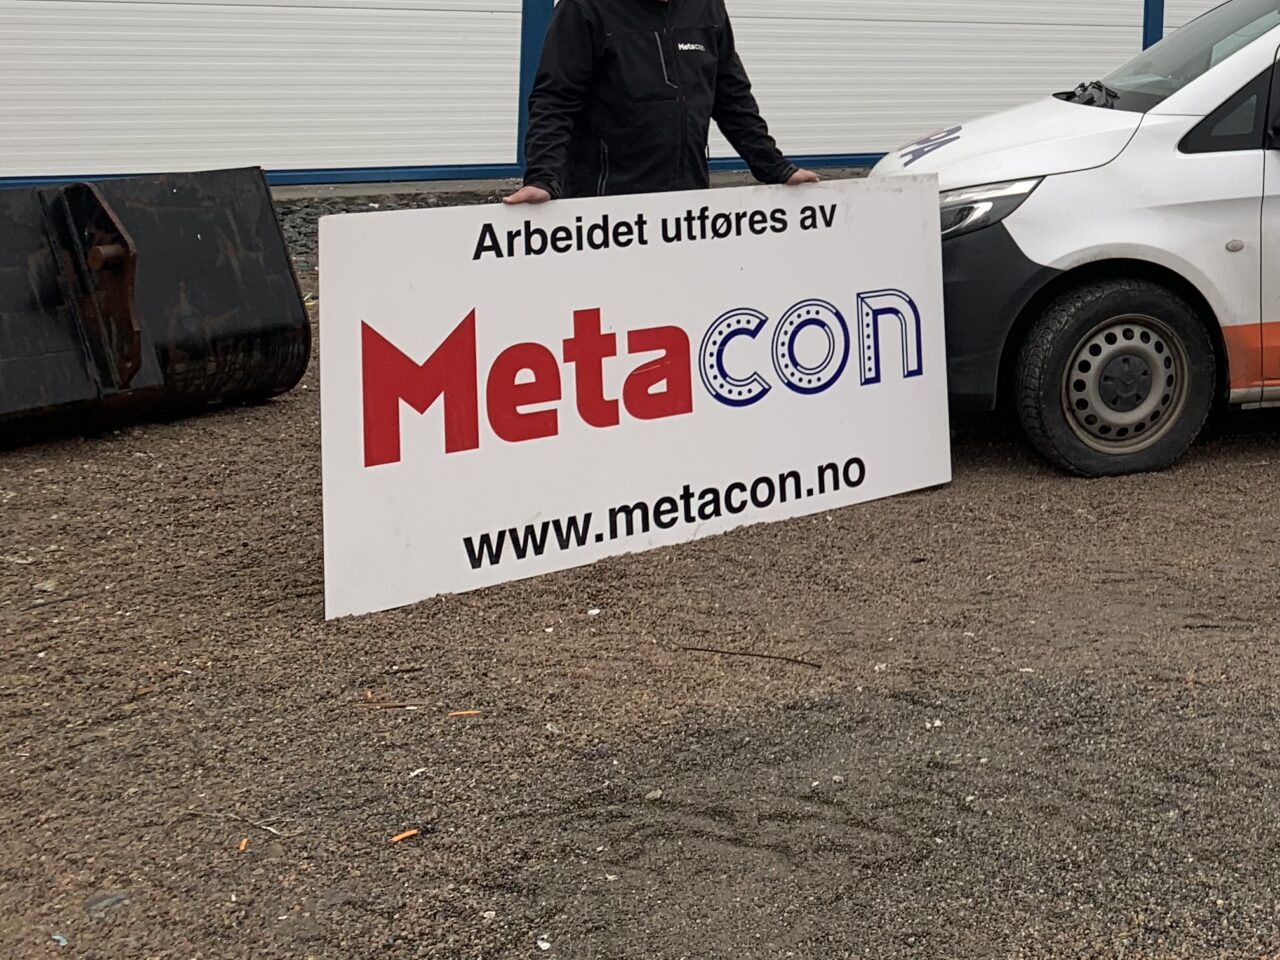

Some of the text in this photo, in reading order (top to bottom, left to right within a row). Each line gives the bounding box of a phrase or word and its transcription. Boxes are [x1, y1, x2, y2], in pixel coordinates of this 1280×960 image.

[473, 203, 837, 261] Arbeidet utføres av
[361, 289, 923, 468] Metacon
[463, 456, 866, 569] www.metacon.no
